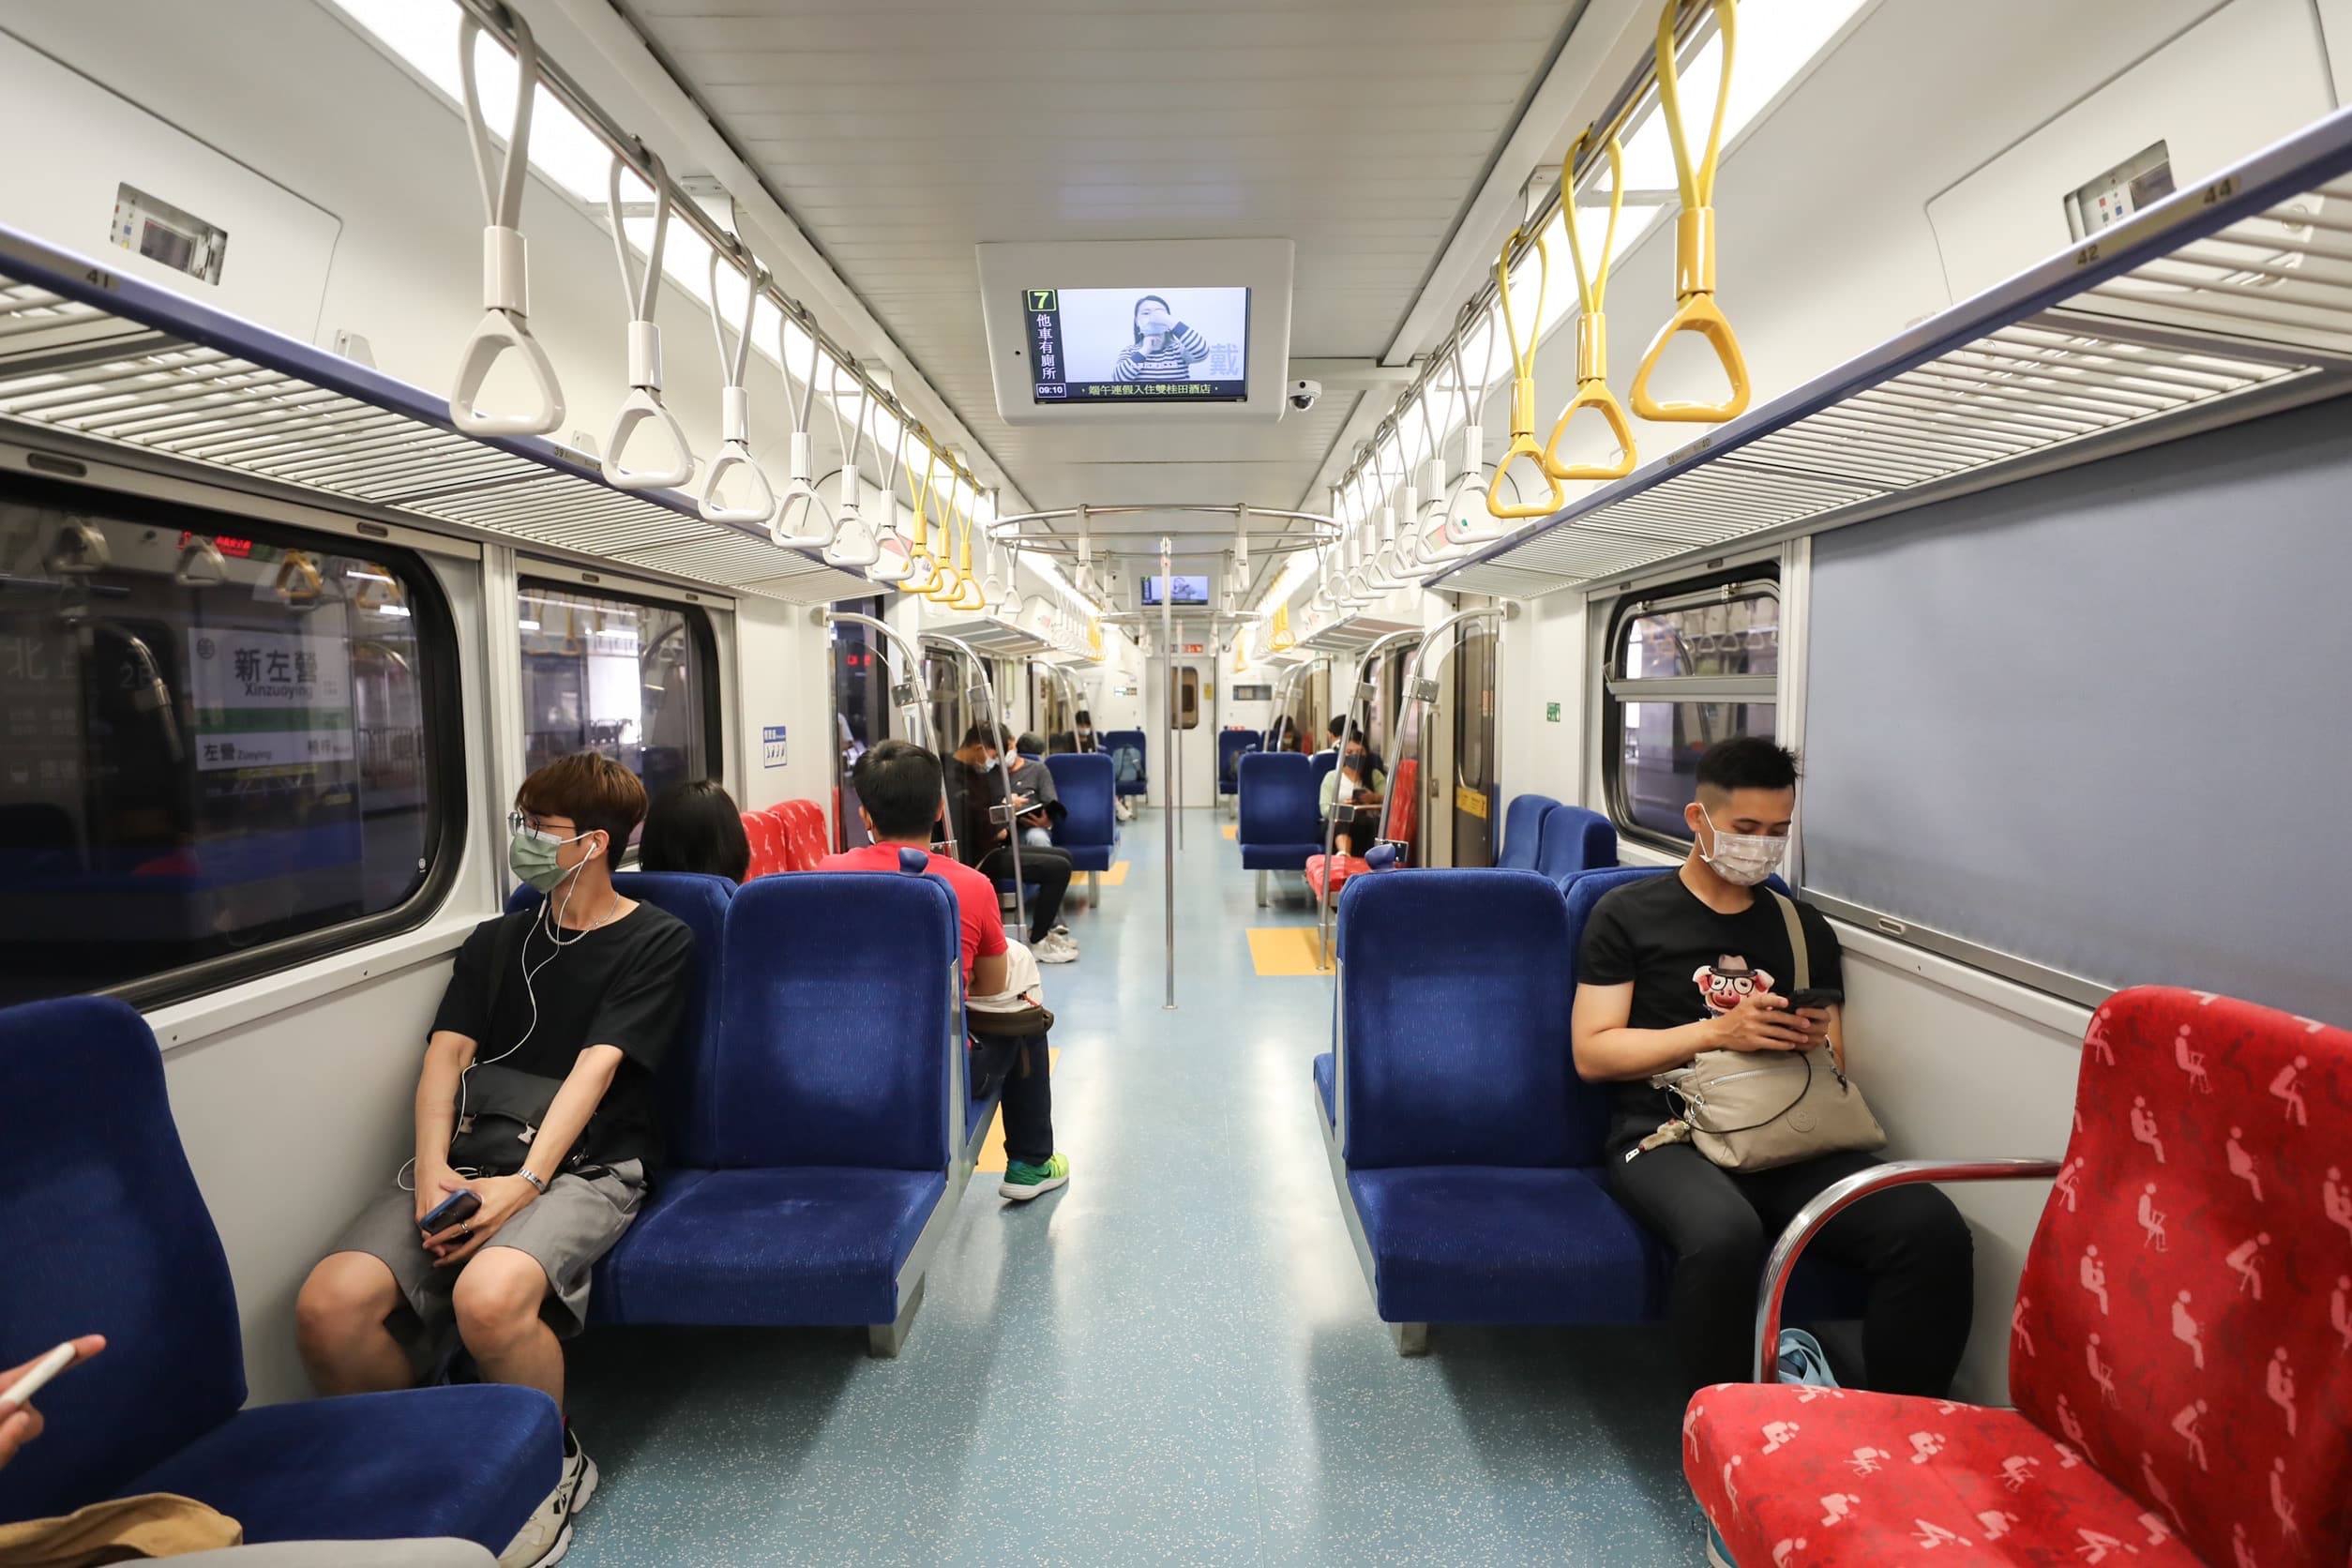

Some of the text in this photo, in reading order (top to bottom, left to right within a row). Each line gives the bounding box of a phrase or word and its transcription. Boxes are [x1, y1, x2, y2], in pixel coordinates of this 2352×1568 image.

[2077, 244, 2100, 265] 42
[86, 269, 109, 288] 41
[1033, 293, 1049, 309] 7
[1039, 385, 1063, 395] 09:10
[234, 648, 317, 685] 新左營
[245, 683, 313, 701] Xinzuoying
